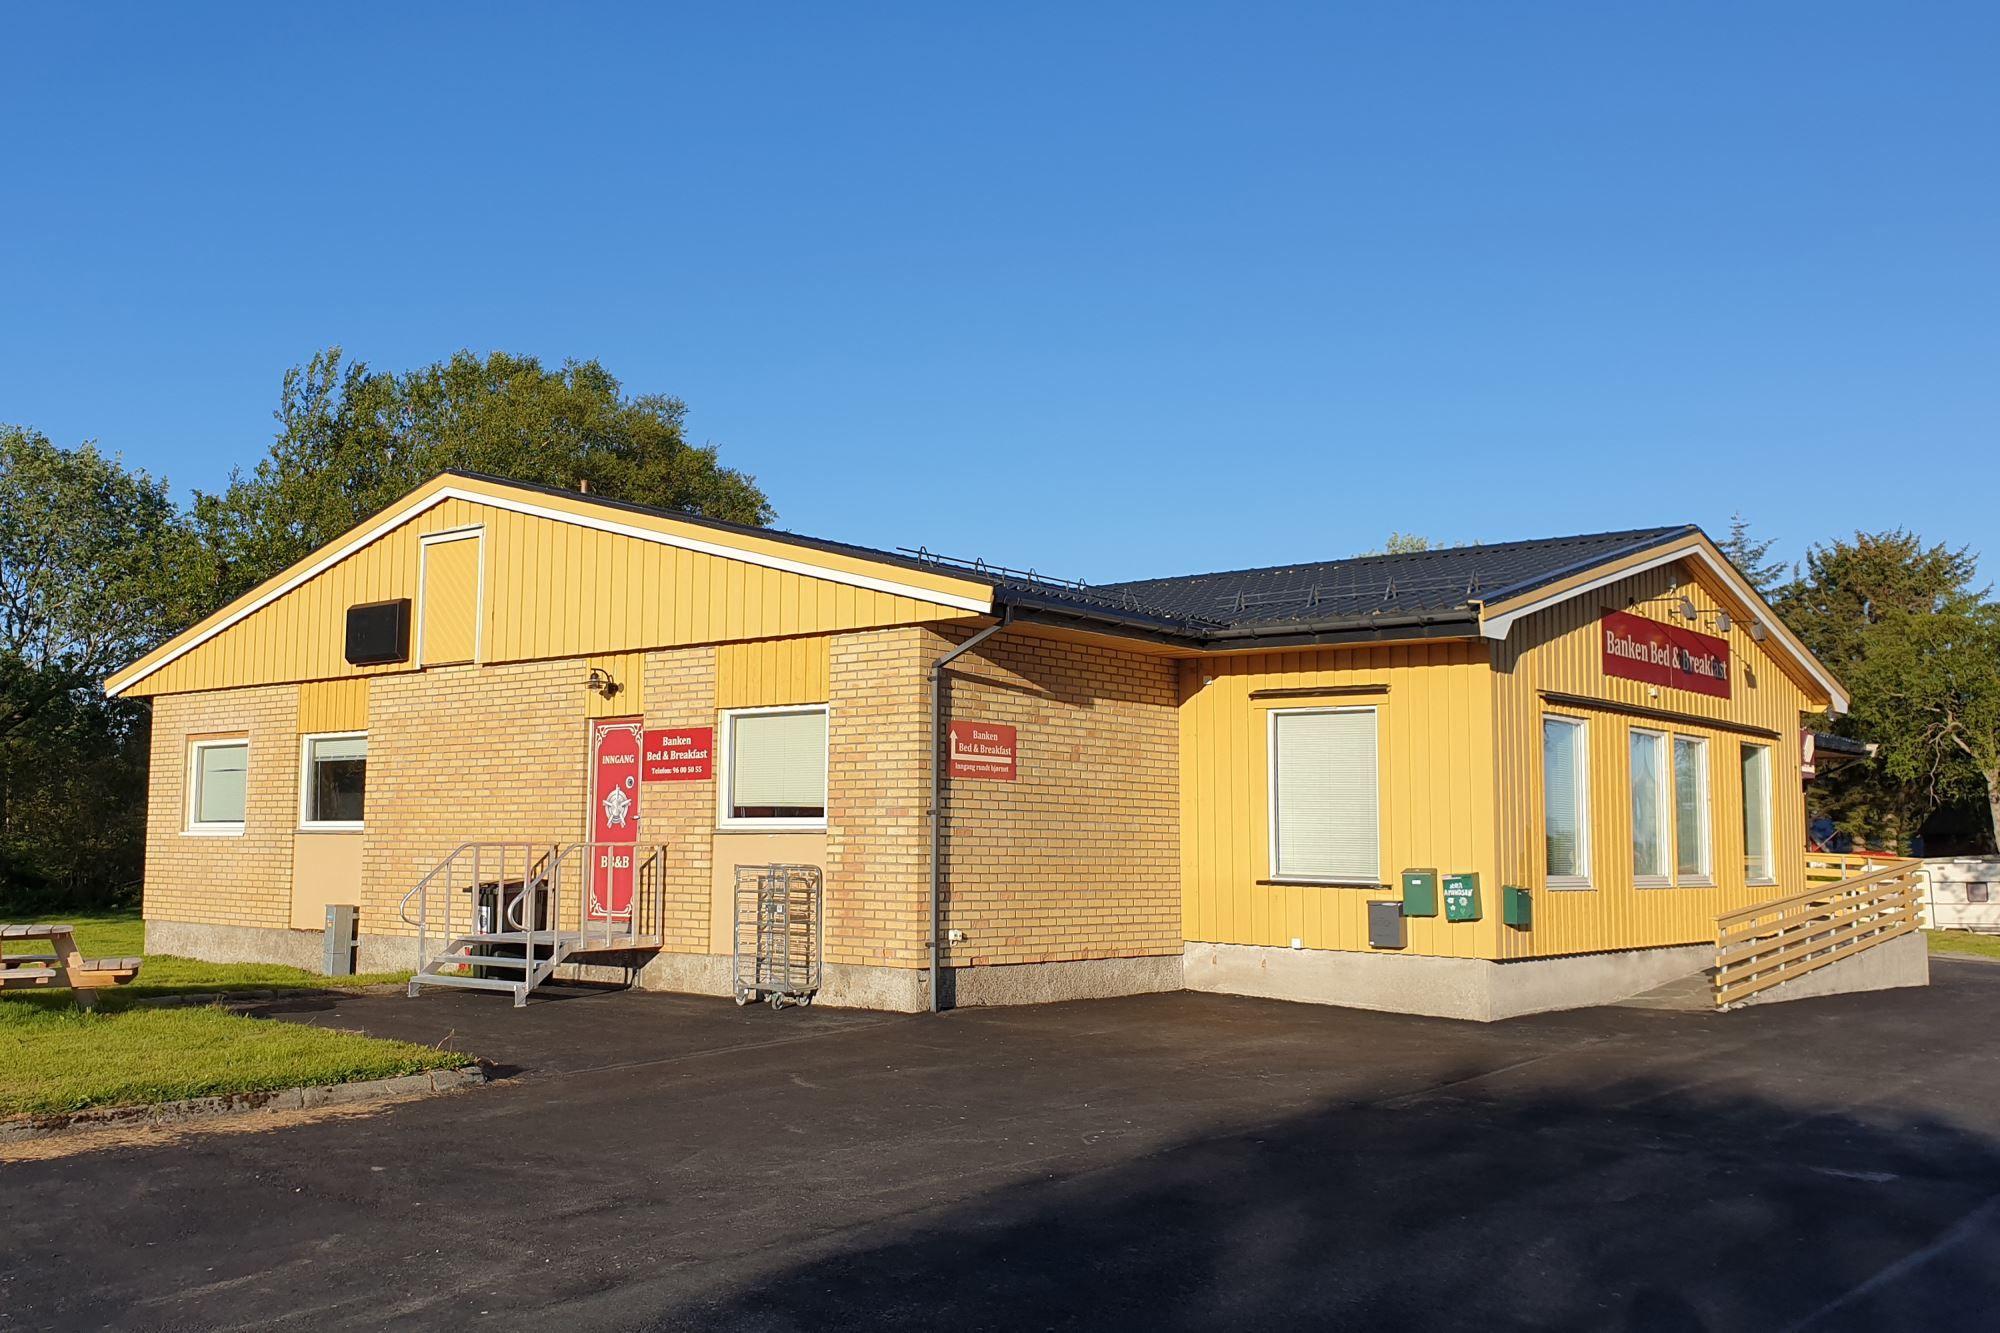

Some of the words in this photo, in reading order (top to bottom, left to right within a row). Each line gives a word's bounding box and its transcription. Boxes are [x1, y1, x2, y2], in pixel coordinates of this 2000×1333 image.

[1606, 630, 1649, 662] Banken
[1650, 641, 1671, 667] Bed
[1672, 646, 1681, 669] &
[1682, 649, 1728, 680] Breakfast
[662, 736, 691, 746] Banken
[973, 730, 998, 741] Banken
[959, 742, 972, 752] Bed
[973, 743, 979, 753] &
[980, 744, 1011, 755] Breakfast
[602, 755, 634, 764] INNGANG
[646, 751, 661, 761] Bed
[662, 750, 669, 760] &
[670, 749, 708, 760] Breakfast
[695, 765, 703, 773] 55
